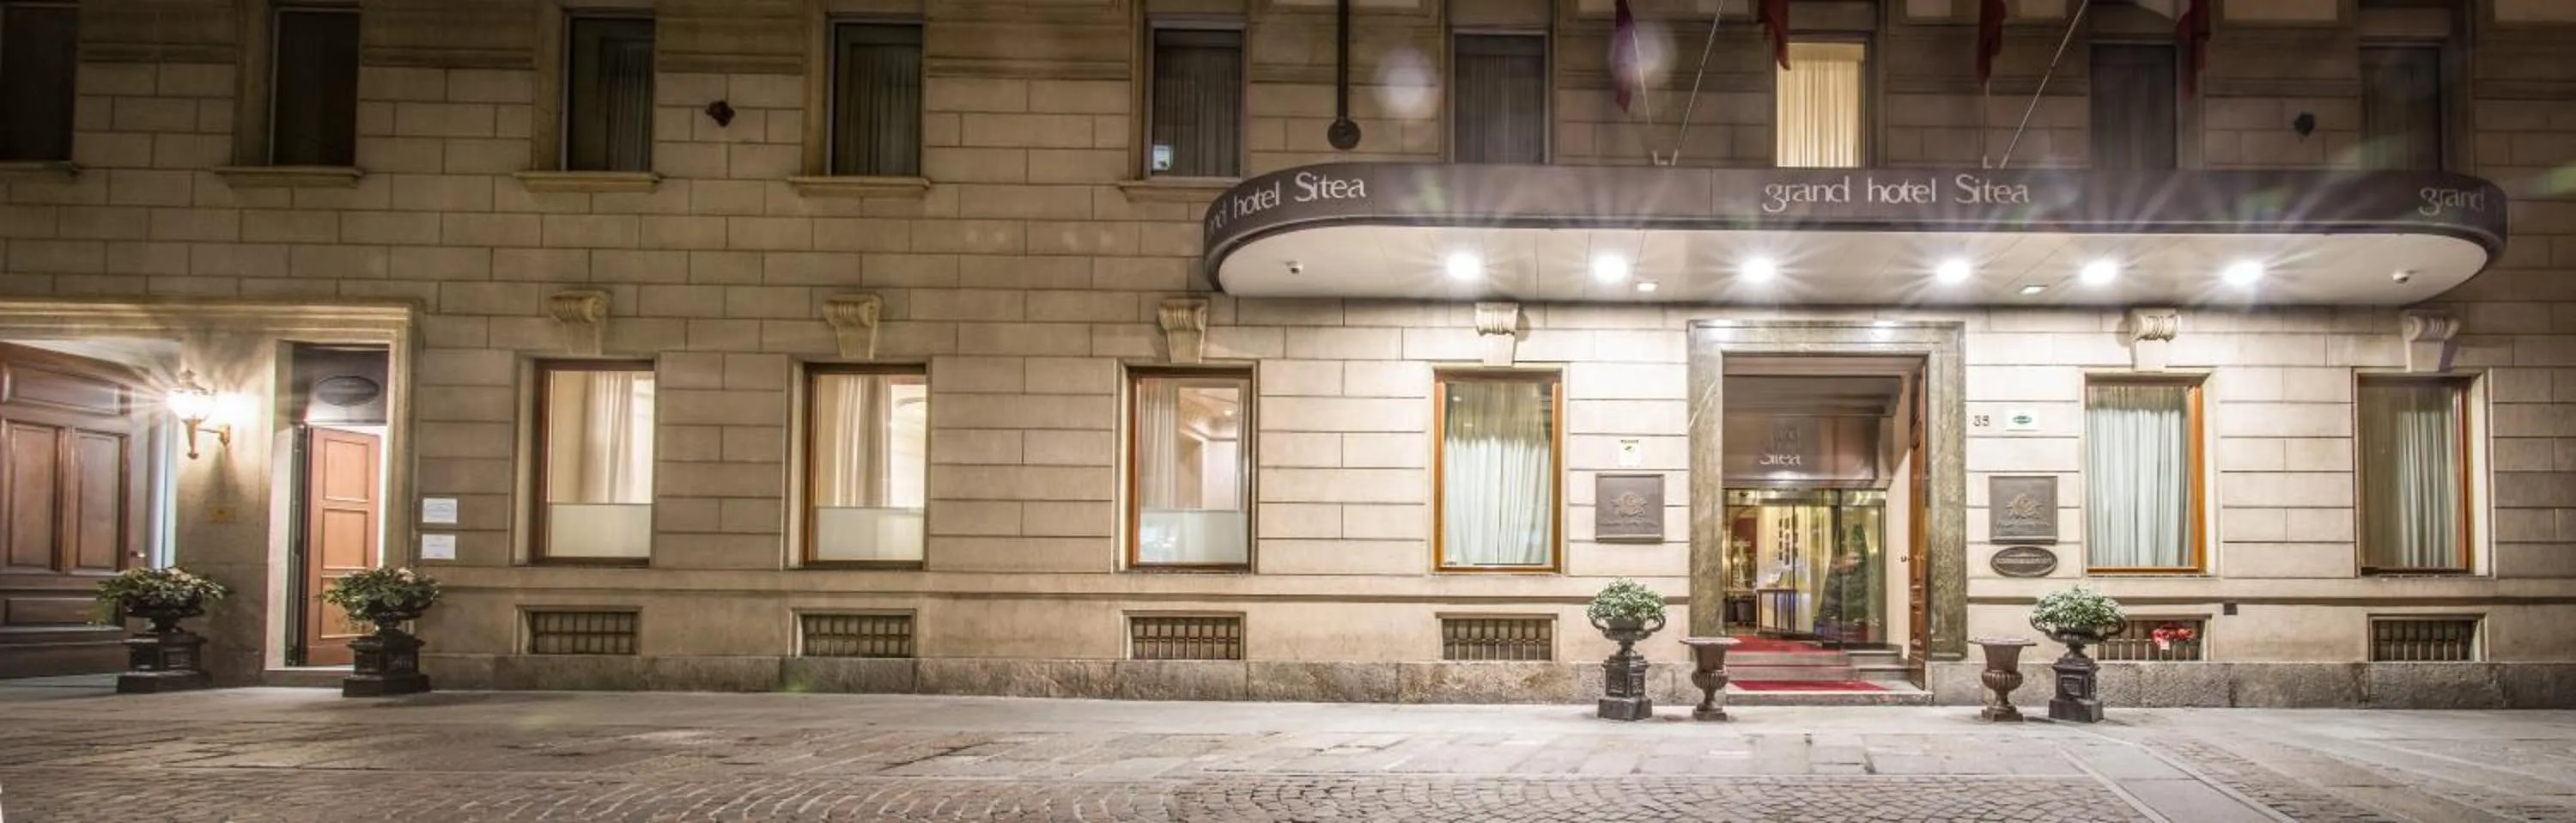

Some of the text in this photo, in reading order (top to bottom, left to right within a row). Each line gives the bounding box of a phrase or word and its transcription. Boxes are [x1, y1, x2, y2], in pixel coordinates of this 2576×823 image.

[1233, 179, 1280, 219] hotel
[1294, 171, 1367, 203] Sitea
[1762, 173, 2031, 213] grand hotel Sitea
[2417, 186, 2485, 216] grand
